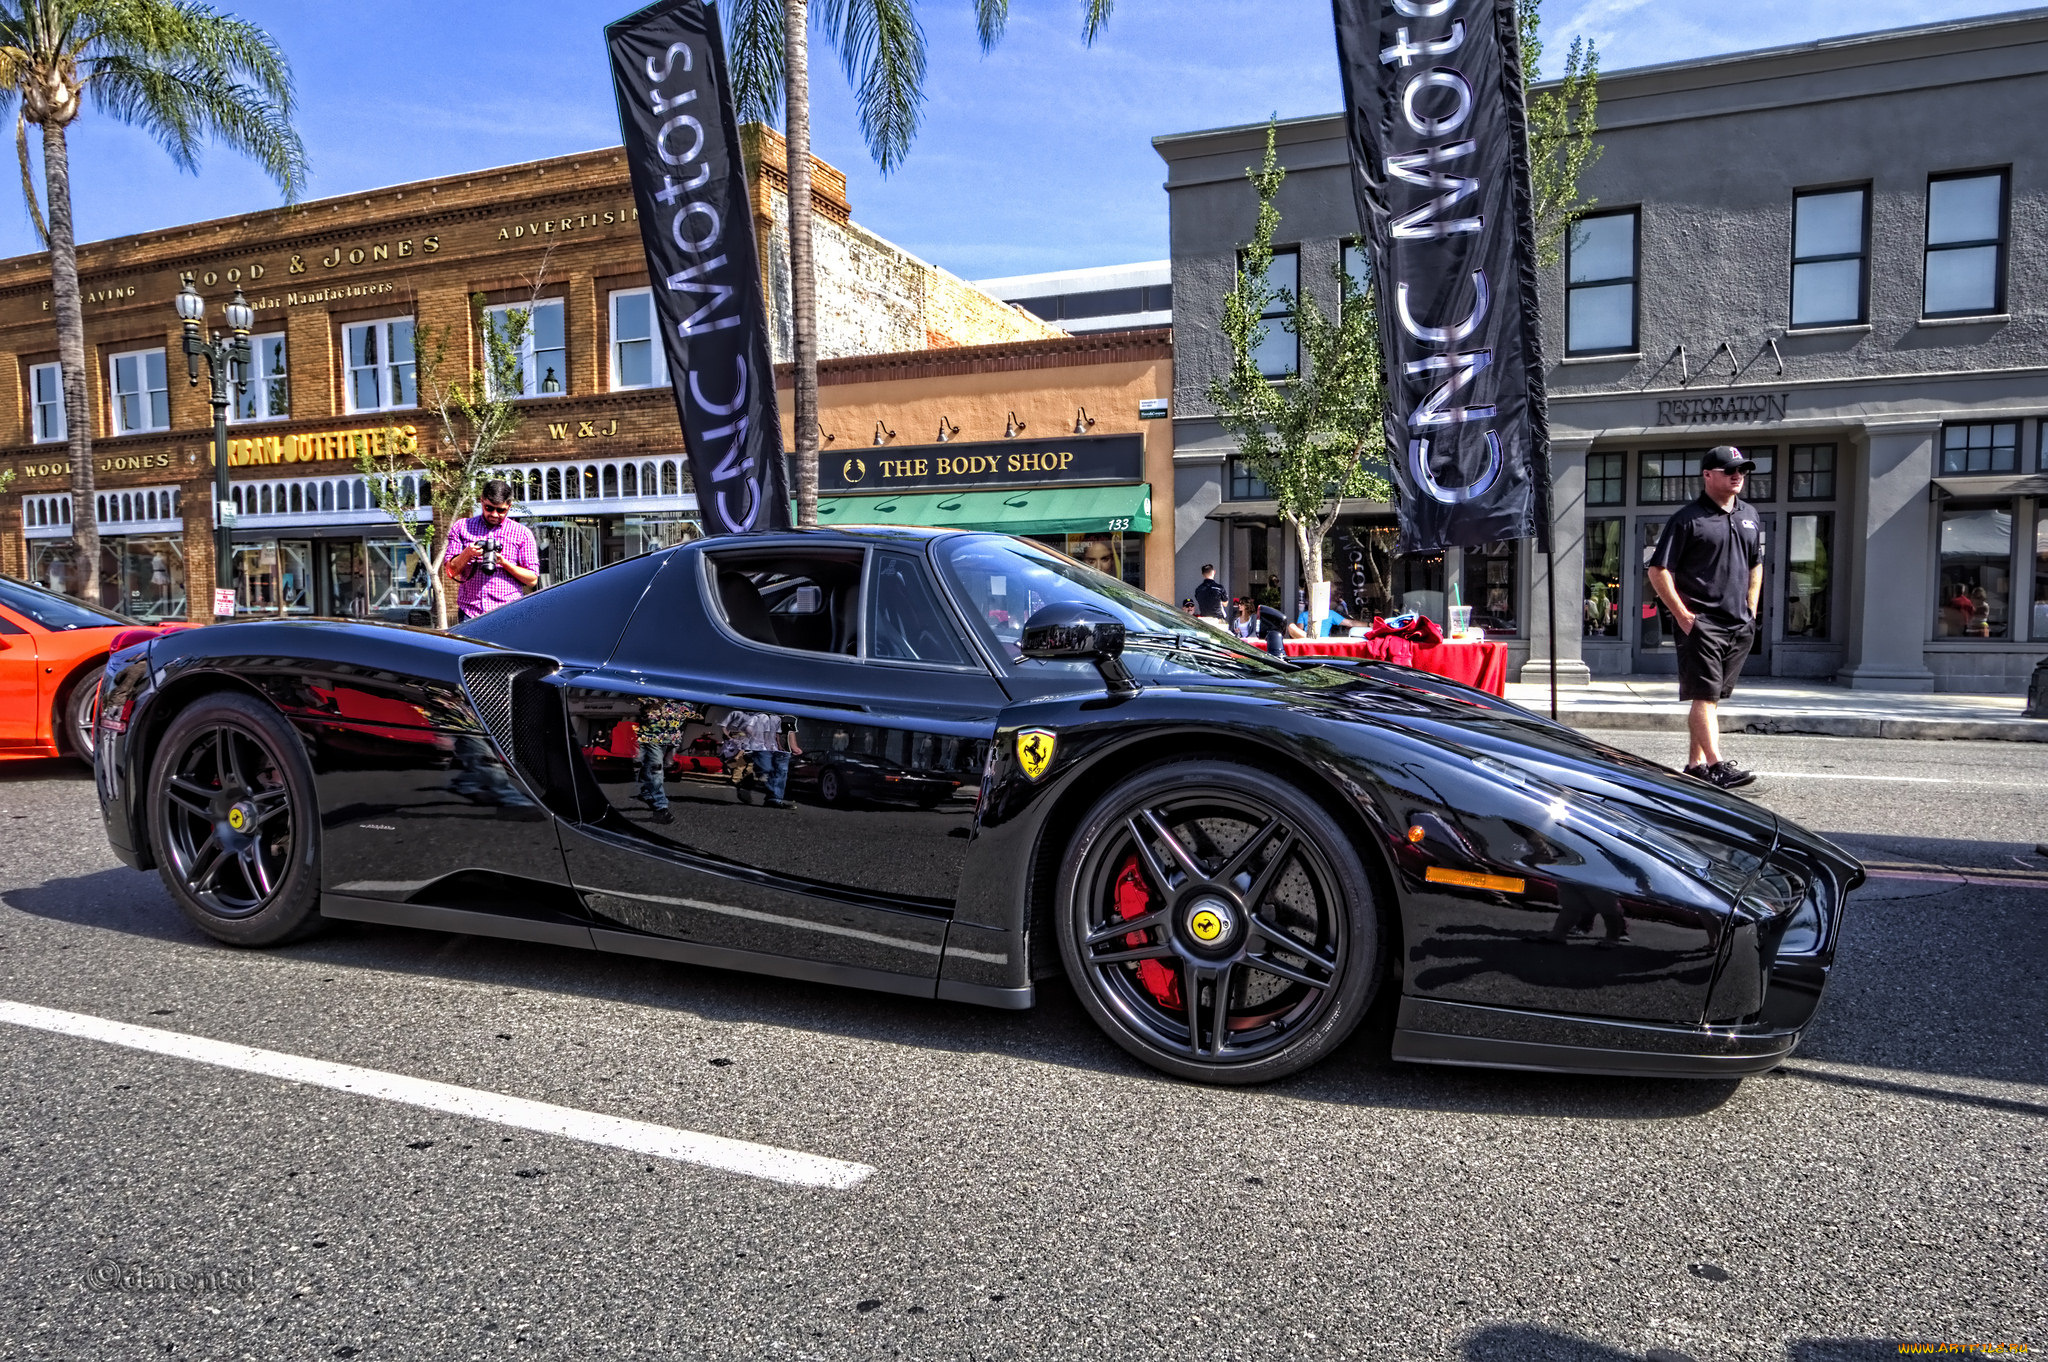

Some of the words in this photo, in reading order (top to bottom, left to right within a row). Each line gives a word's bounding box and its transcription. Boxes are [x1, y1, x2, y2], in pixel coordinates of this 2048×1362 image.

[1379, 0, 1485, 240] Mot
[646, 40, 742, 338] Motors
[498, 208, 639, 240] ADVERTISIN
[179, 263, 265, 288] WOOD
[289, 254, 307, 275] &
[323, 235, 440, 268] JONES
[287, 281, 394, 307] Manufacturers
[1396, 267, 1503, 505] CNC
[1656, 393, 1790, 426] RESTORATION
[283, 424, 418, 463] OUTFITTERS
[547, 422, 569, 440] W
[577, 420, 596, 438] &
[601, 419, 619, 436] J
[689, 353, 762, 534] CNC
[102, 453, 170, 471] JONES
[879, 459, 928, 478] THE
[936, 455, 1002, 476] BODY
[1007, 451, 1074, 473] SHOP
[1108, 518, 1130, 531] 133
